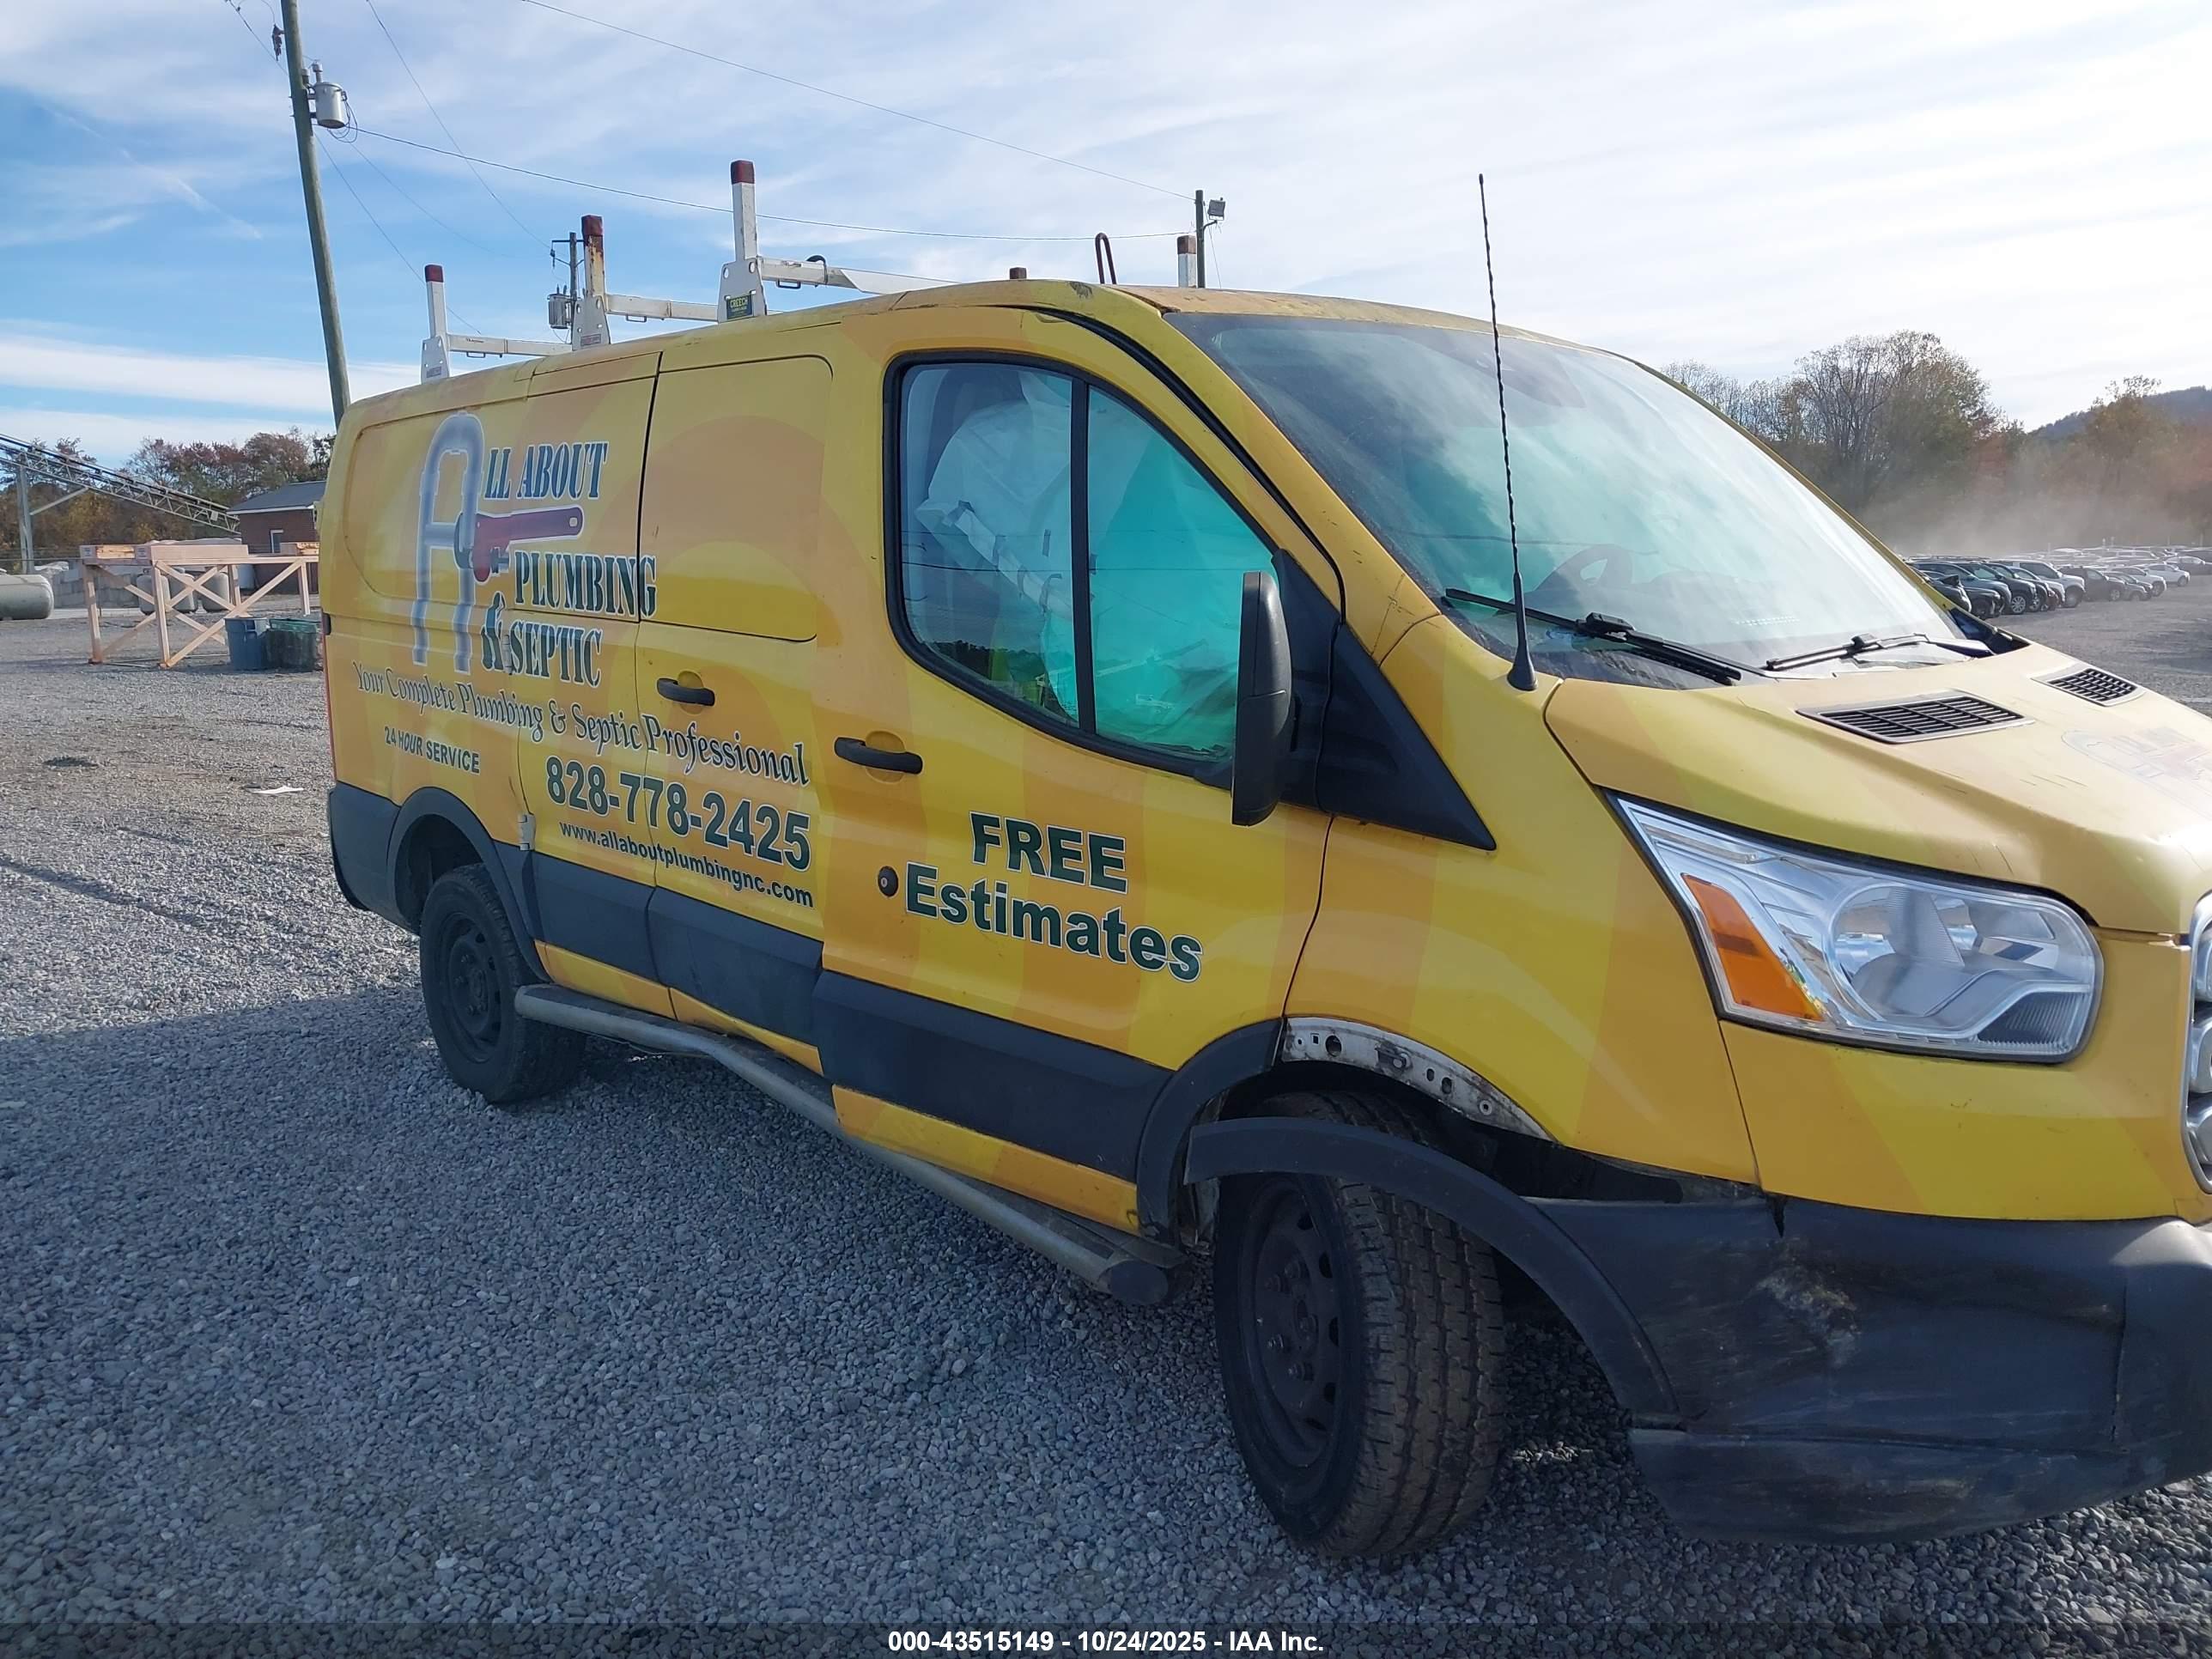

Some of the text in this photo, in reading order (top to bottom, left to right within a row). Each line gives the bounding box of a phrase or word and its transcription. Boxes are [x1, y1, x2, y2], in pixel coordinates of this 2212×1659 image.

[516, 441, 608, 501] ABOUT
[514, 549, 656, 618] PLUMBING
[509, 619, 603, 688] SEPTIC
[353, 660, 811, 787] Your Complete Plumbing & Septic Professional
[384, 726, 480, 775] 24 HOUR SERVICE
[544, 755, 812, 872] 828-778-2425
[969, 810, 1129, 895] FREE
[559, 818, 815, 908] www.allaboutplumbingnc.com
[905, 860, 1204, 984] Estimates
